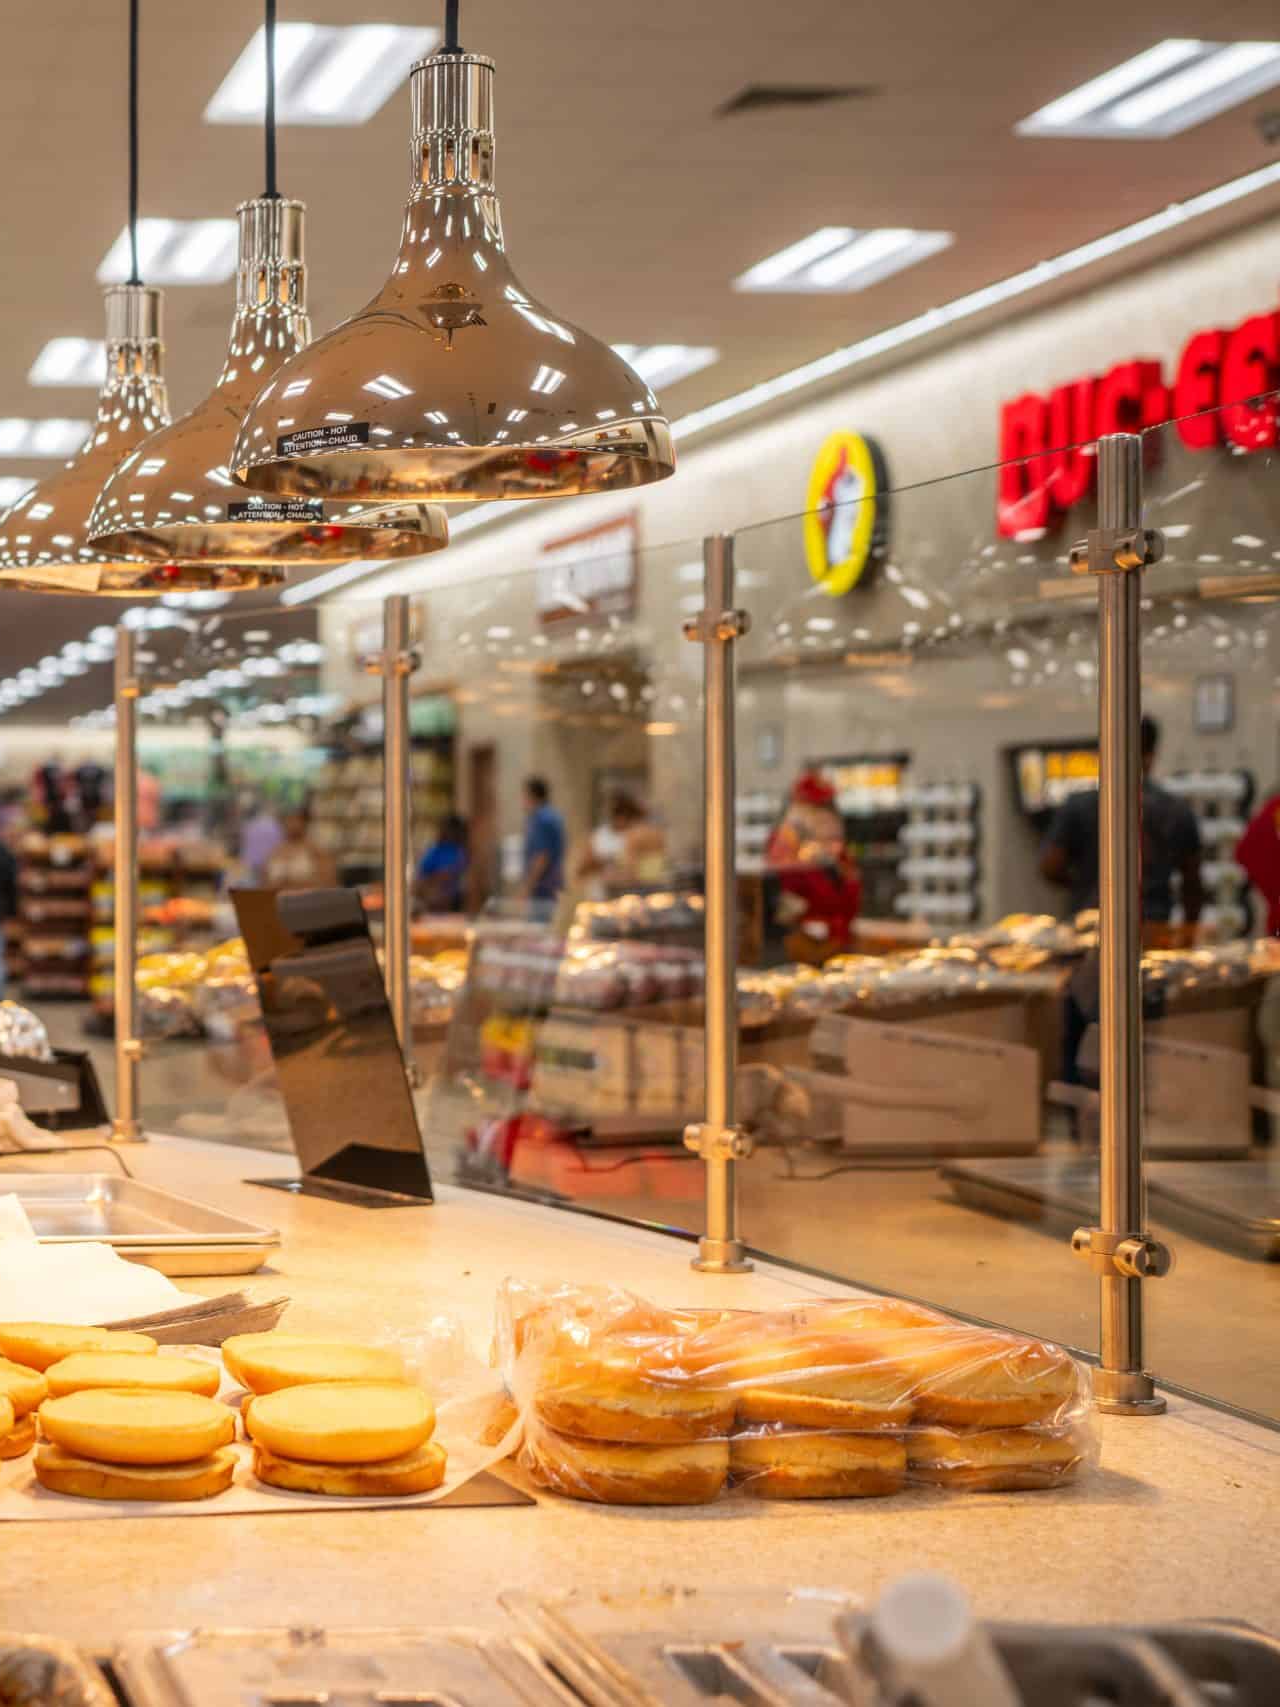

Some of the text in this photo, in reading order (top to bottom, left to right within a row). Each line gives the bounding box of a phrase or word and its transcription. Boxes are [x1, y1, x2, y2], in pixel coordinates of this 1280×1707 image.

[292, 429, 324, 442] CAUTION
[331, 426, 348, 435] HOT
[284, 439, 322, 453] ATTENTION
[328, 434, 358, 445] CHAUD
[238, 511, 280, 519] ATTENTION
[286, 511, 313, 519] CHAUD
